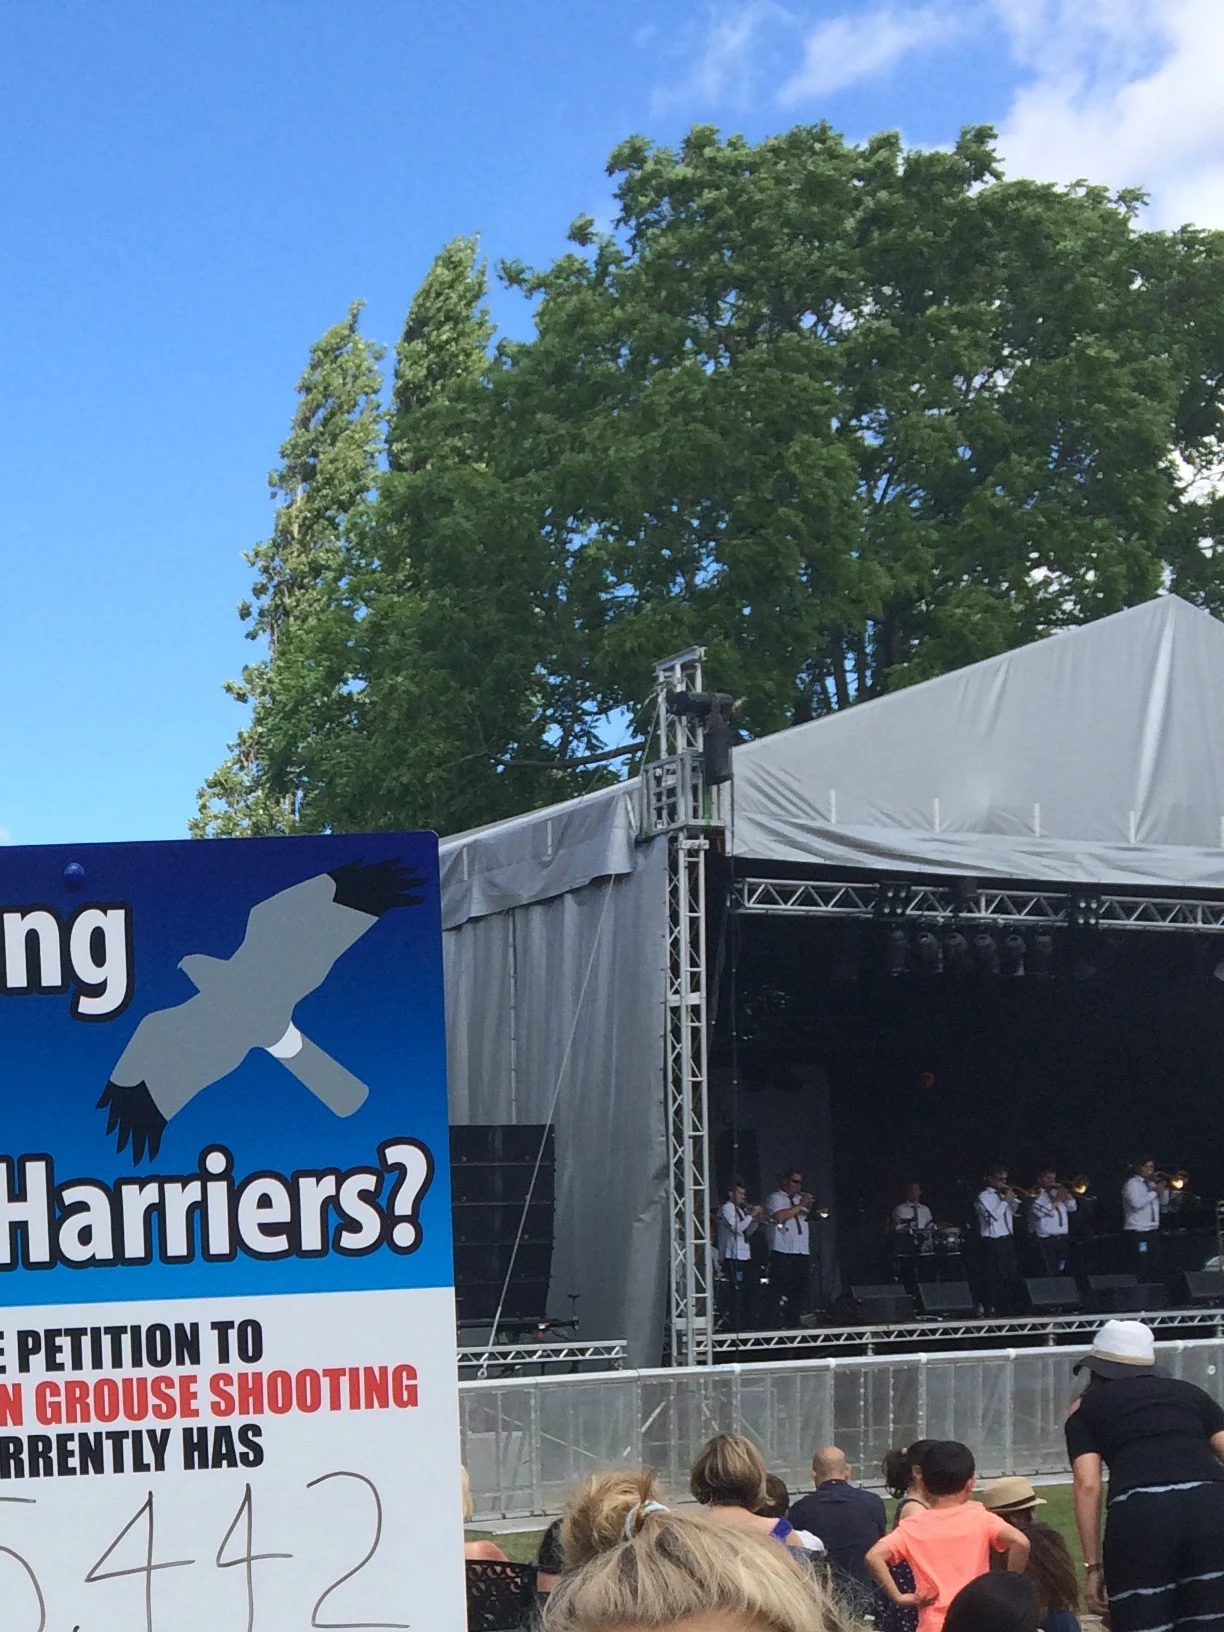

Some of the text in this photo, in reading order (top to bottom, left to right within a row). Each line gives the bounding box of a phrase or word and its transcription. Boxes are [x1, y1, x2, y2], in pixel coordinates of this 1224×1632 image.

[16, 1322, 201, 1374] PETITION
[210, 1318, 263, 1365] TO
[35, 1374, 199, 1425] GROUSE
[210, 1363, 419, 1417] SHOOTING
[182, 1423, 265, 1471] HAS
